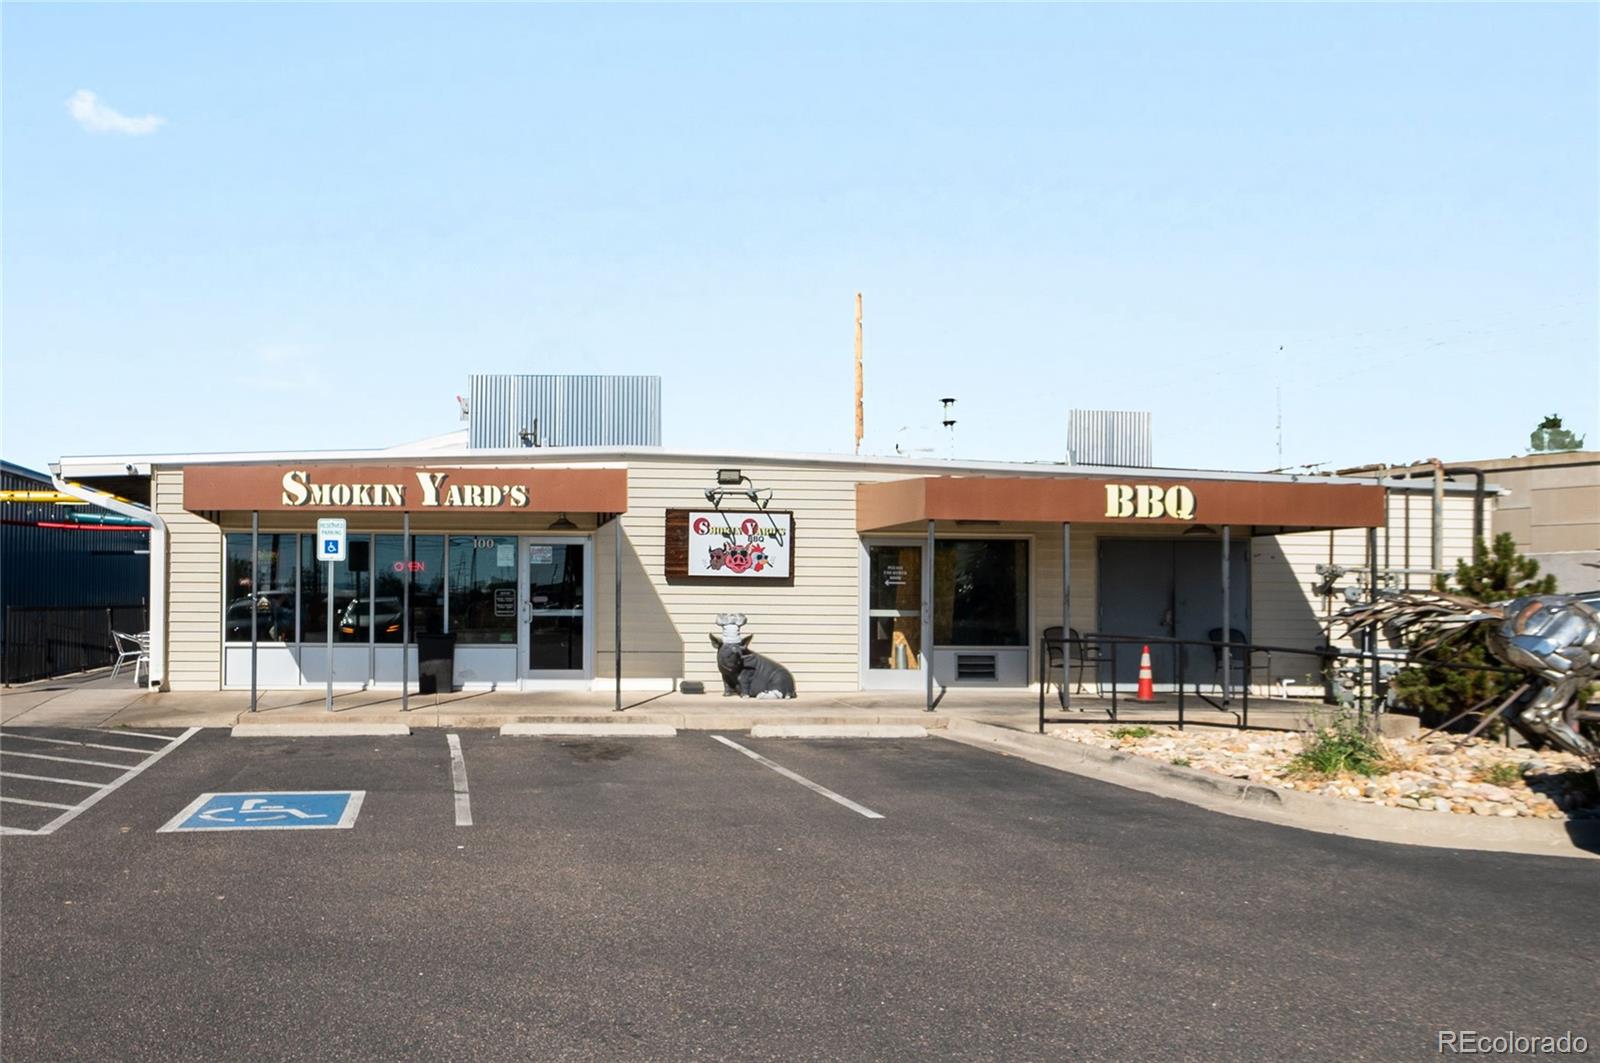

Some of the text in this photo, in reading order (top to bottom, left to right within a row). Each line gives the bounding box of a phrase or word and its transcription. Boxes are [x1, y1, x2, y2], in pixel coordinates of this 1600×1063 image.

[282, 470, 528, 507] SMOKIN YARD'S
[1104, 484, 1195, 520] BBQ
[473, 538, 494, 549] 100
